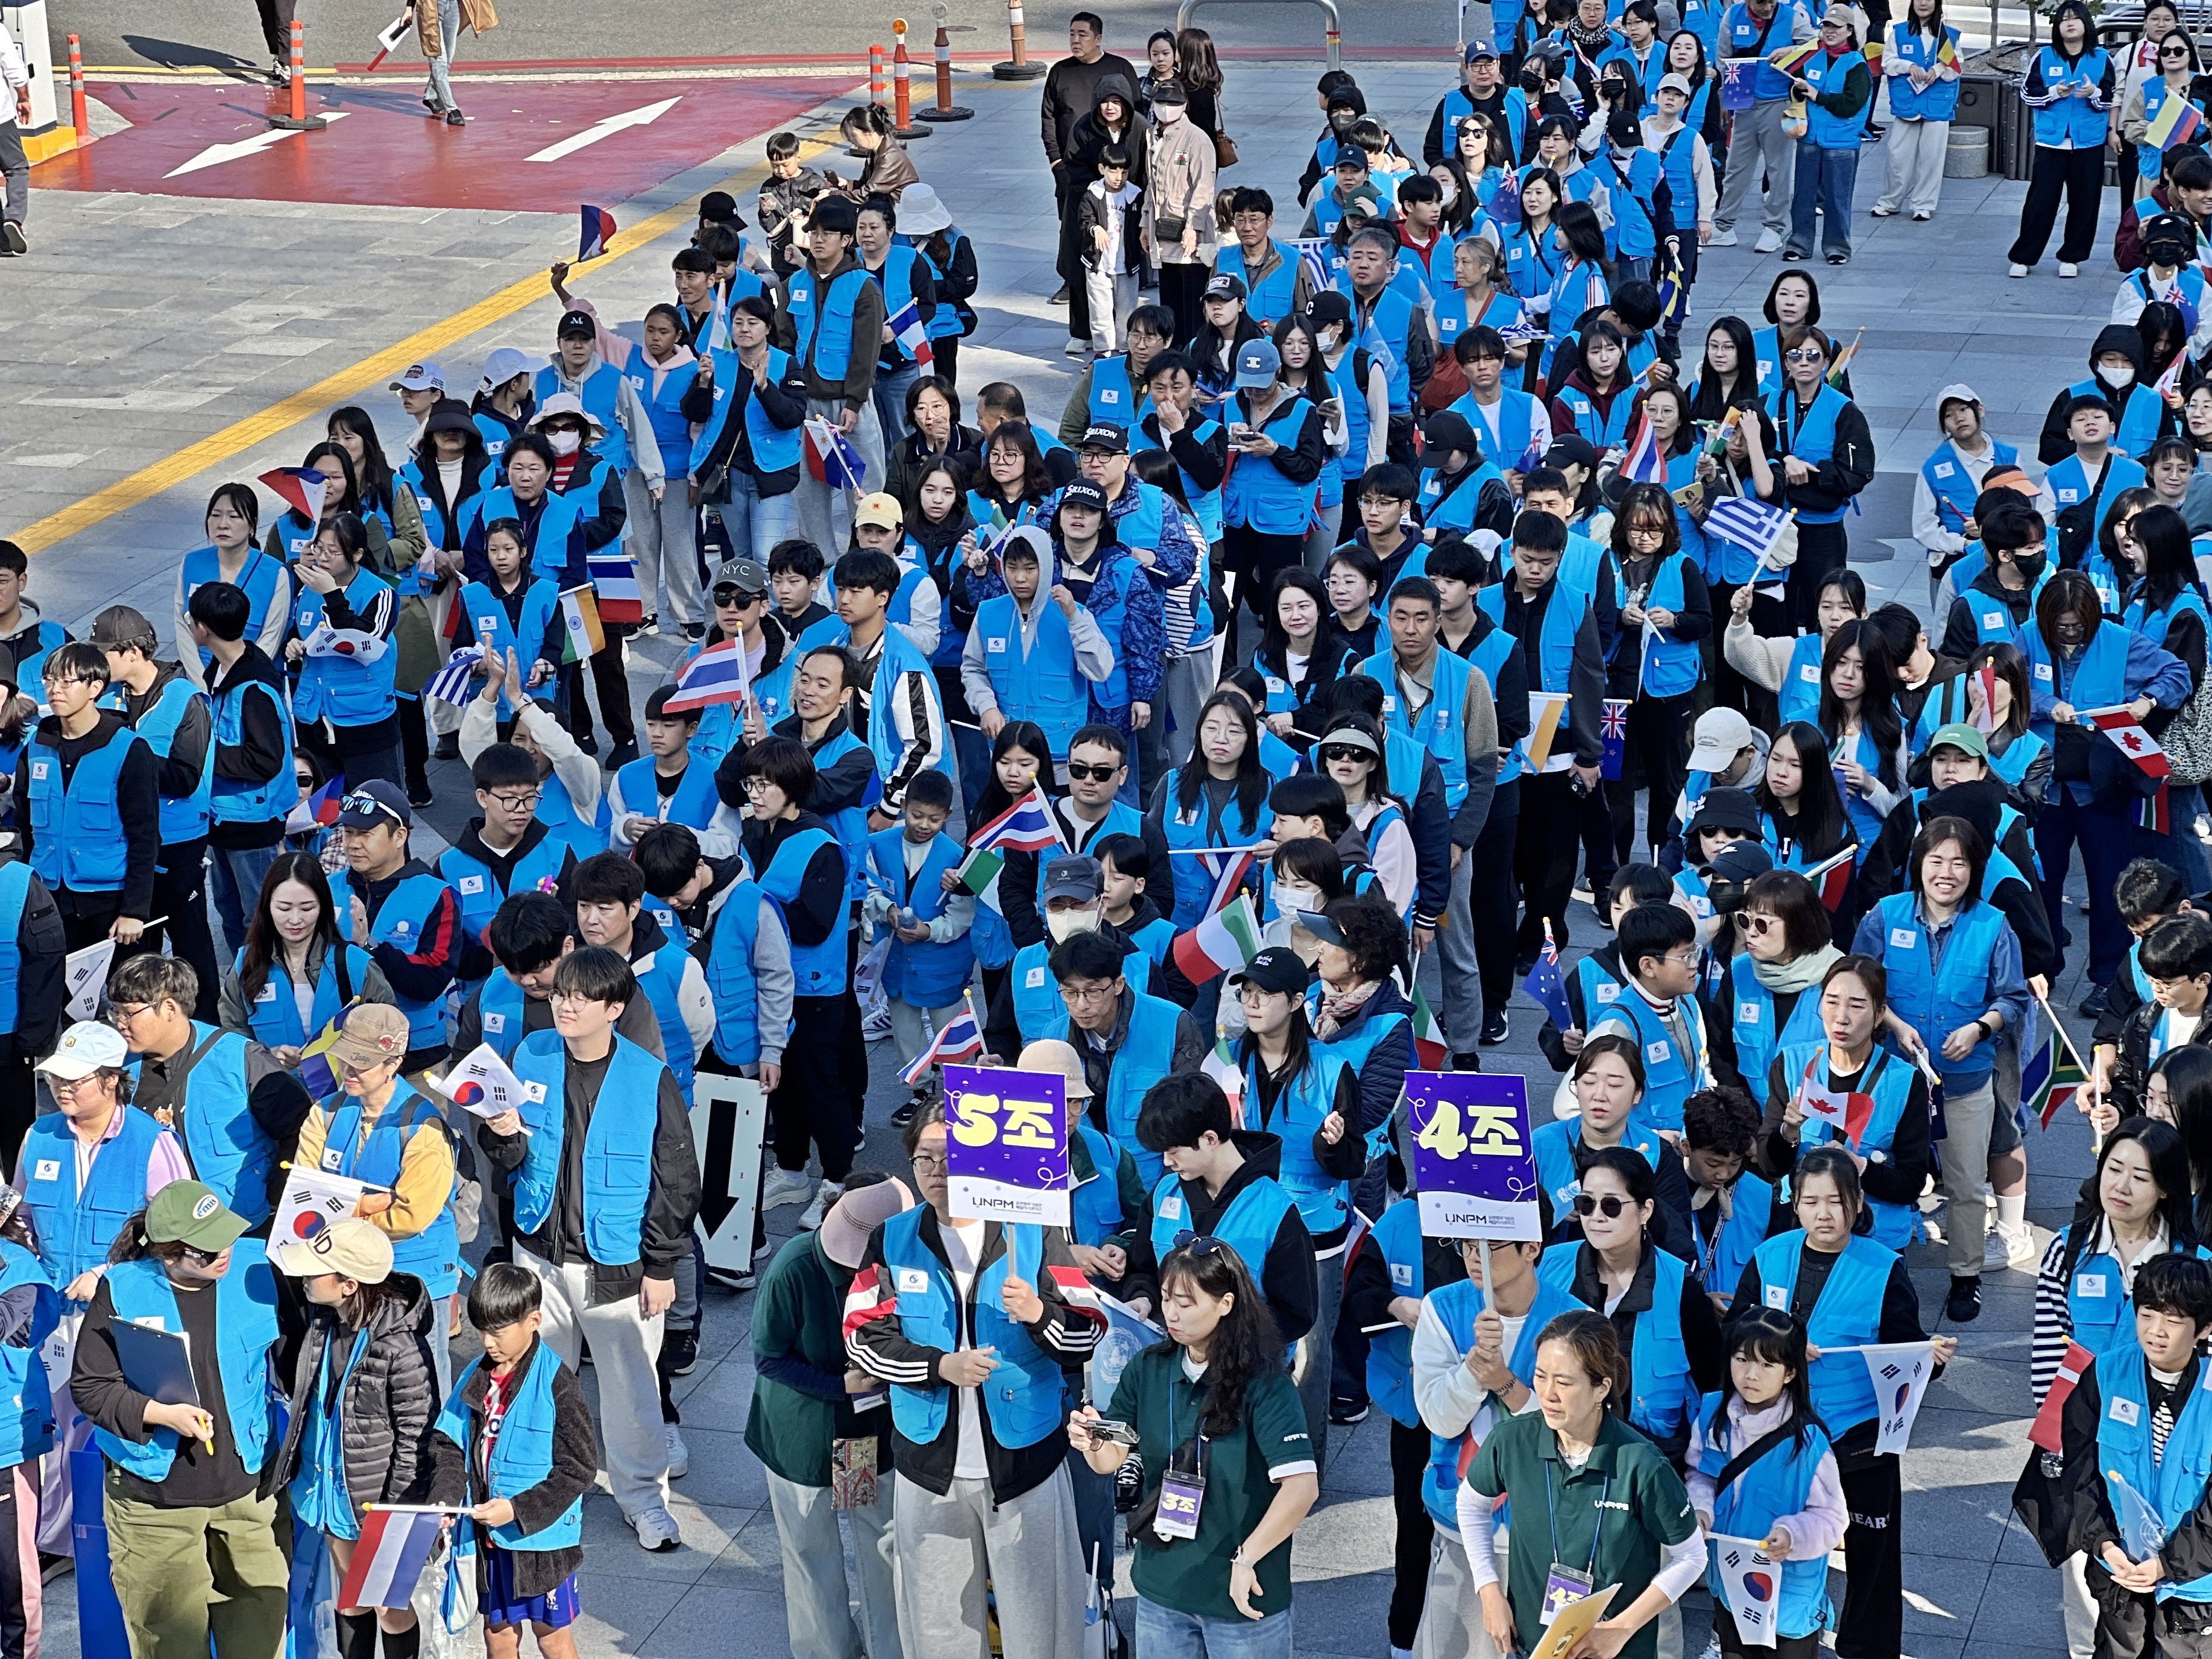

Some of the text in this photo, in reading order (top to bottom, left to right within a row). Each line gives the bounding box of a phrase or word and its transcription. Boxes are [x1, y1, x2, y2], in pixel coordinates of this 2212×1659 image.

[1083, 427, 1118, 442] SRIXON
[1063, 484, 1101, 500] SRIXON
[722, 564, 751, 576] NYC
[350, 1052, 371, 1065] Jeep
[952, 1093, 1056, 1150] 5조
[1418, 1100, 1523, 1160] 4조
[197, 1198, 218, 1218] emis
[972, 1197, 1015, 1209] UNPM
[1445, 1214, 1487, 1226] UNPM
[1162, 1492, 1196, 1514] 3조
[1850, 1511, 1890, 1529] EAR
